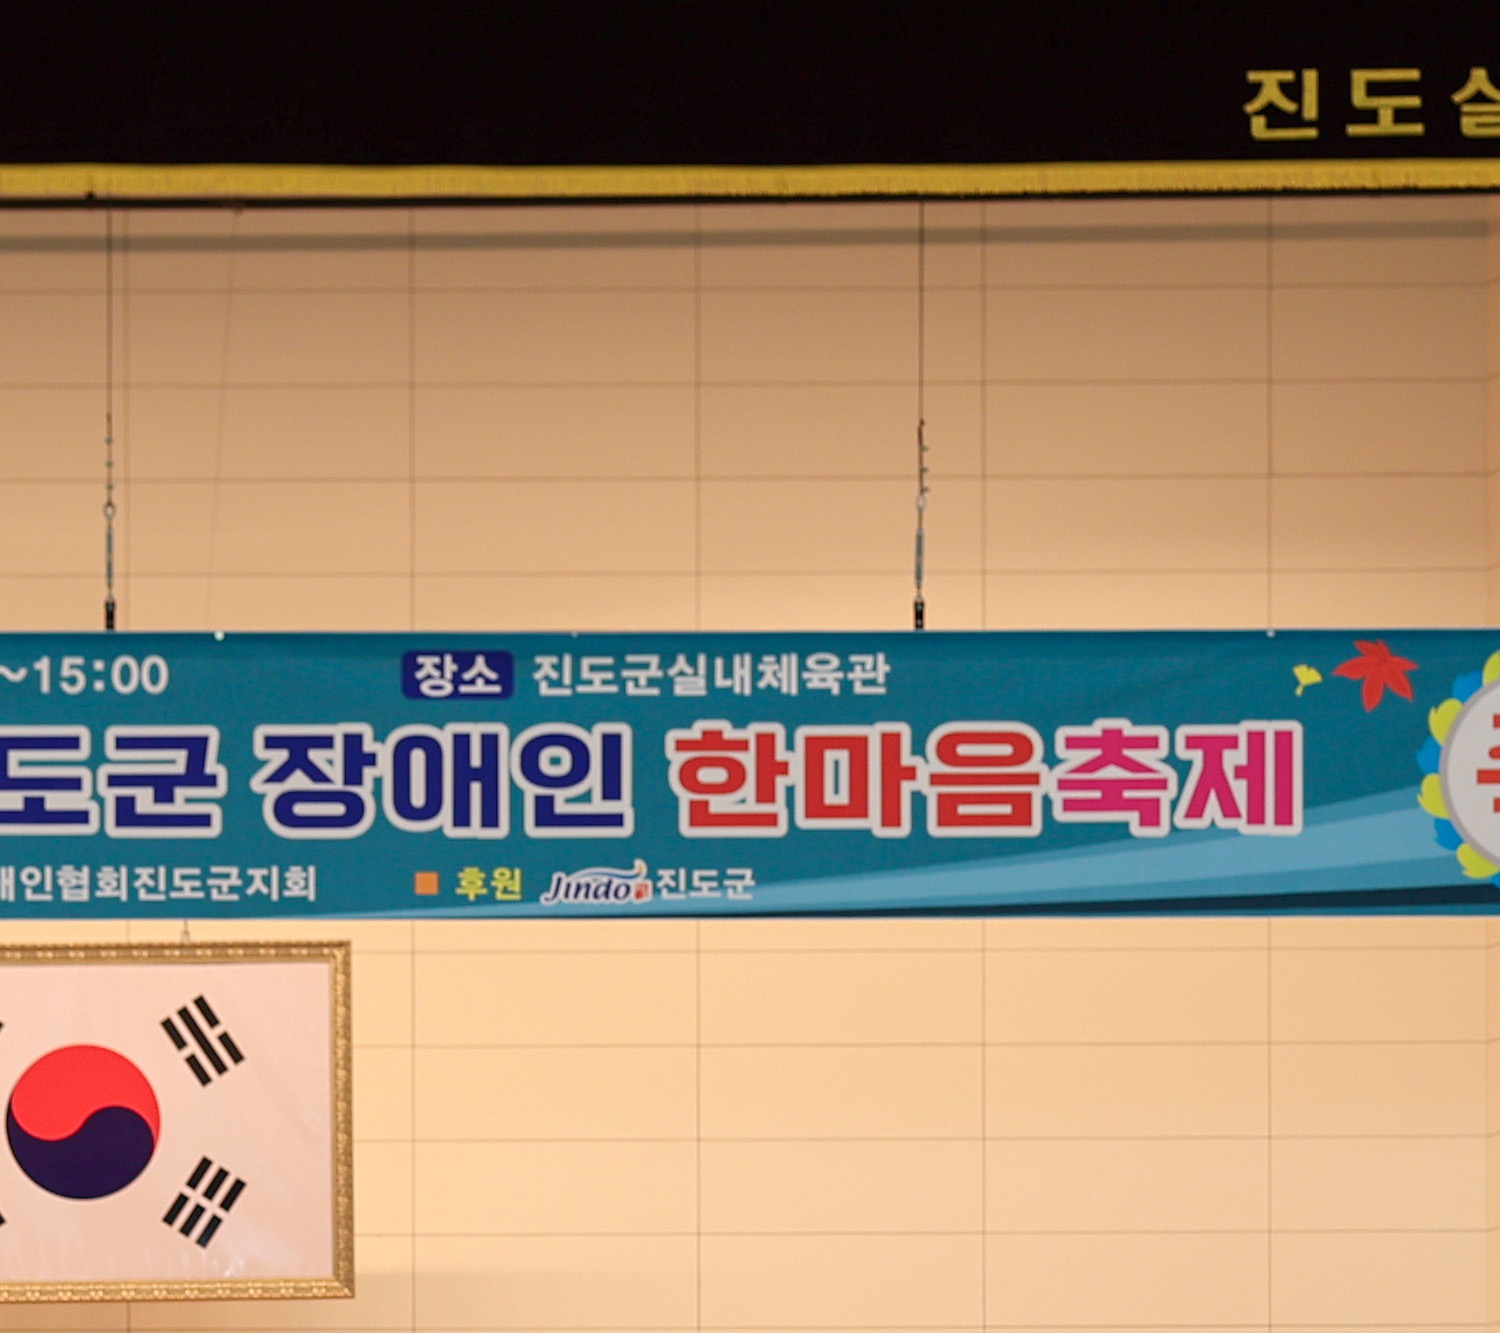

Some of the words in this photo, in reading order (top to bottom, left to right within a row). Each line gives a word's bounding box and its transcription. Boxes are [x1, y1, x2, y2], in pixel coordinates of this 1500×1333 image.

[413, 654, 504, 697] 장소
[532, 653, 891, 697] 진도군실내체육관
[254, 725, 630, 835] 장애인
[669, 722, 1301, 834] 한마음축제
[455, 867, 523, 901] 후원
[543, 874, 631, 903] Jindo
[656, 867, 756, 900] 진도군
